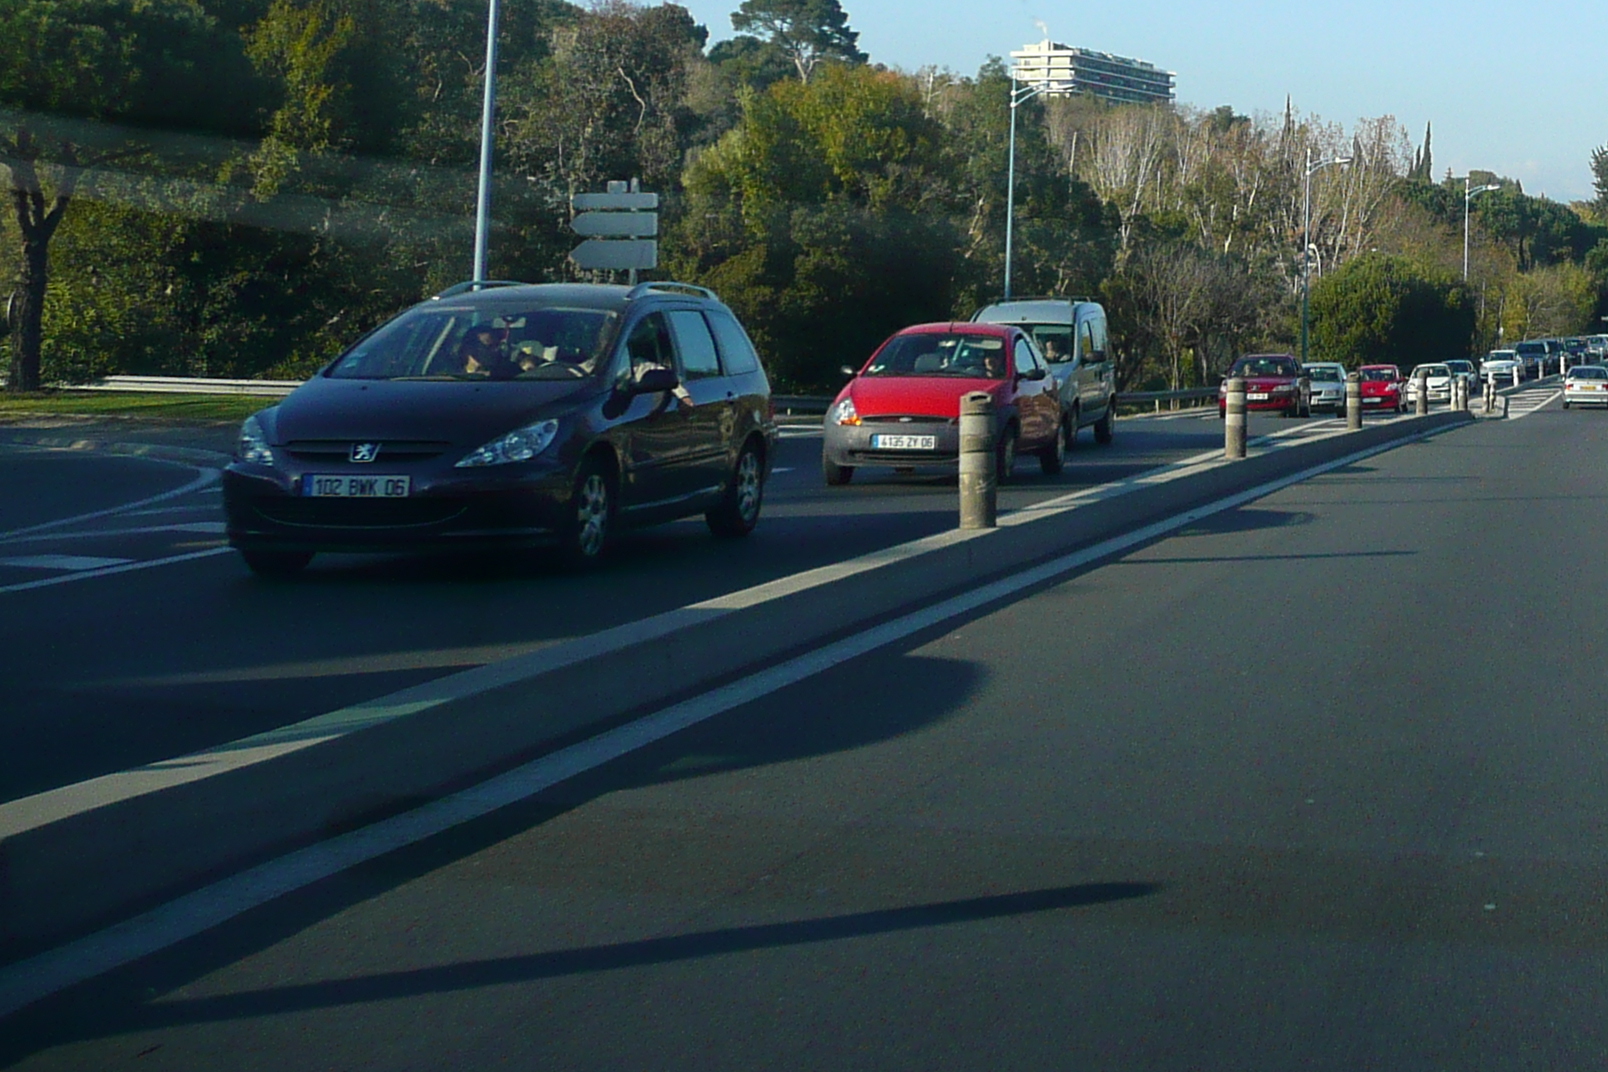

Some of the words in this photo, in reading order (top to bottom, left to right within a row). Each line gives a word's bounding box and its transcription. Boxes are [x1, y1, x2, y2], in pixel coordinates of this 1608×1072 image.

[881, 436, 904, 447] 4135
[907, 436, 918, 447] ZY
[921, 436, 933, 447] 06
[316, 478, 342, 495] 102
[349, 478, 377, 496] BWK
[385, 478, 405, 496] 06
